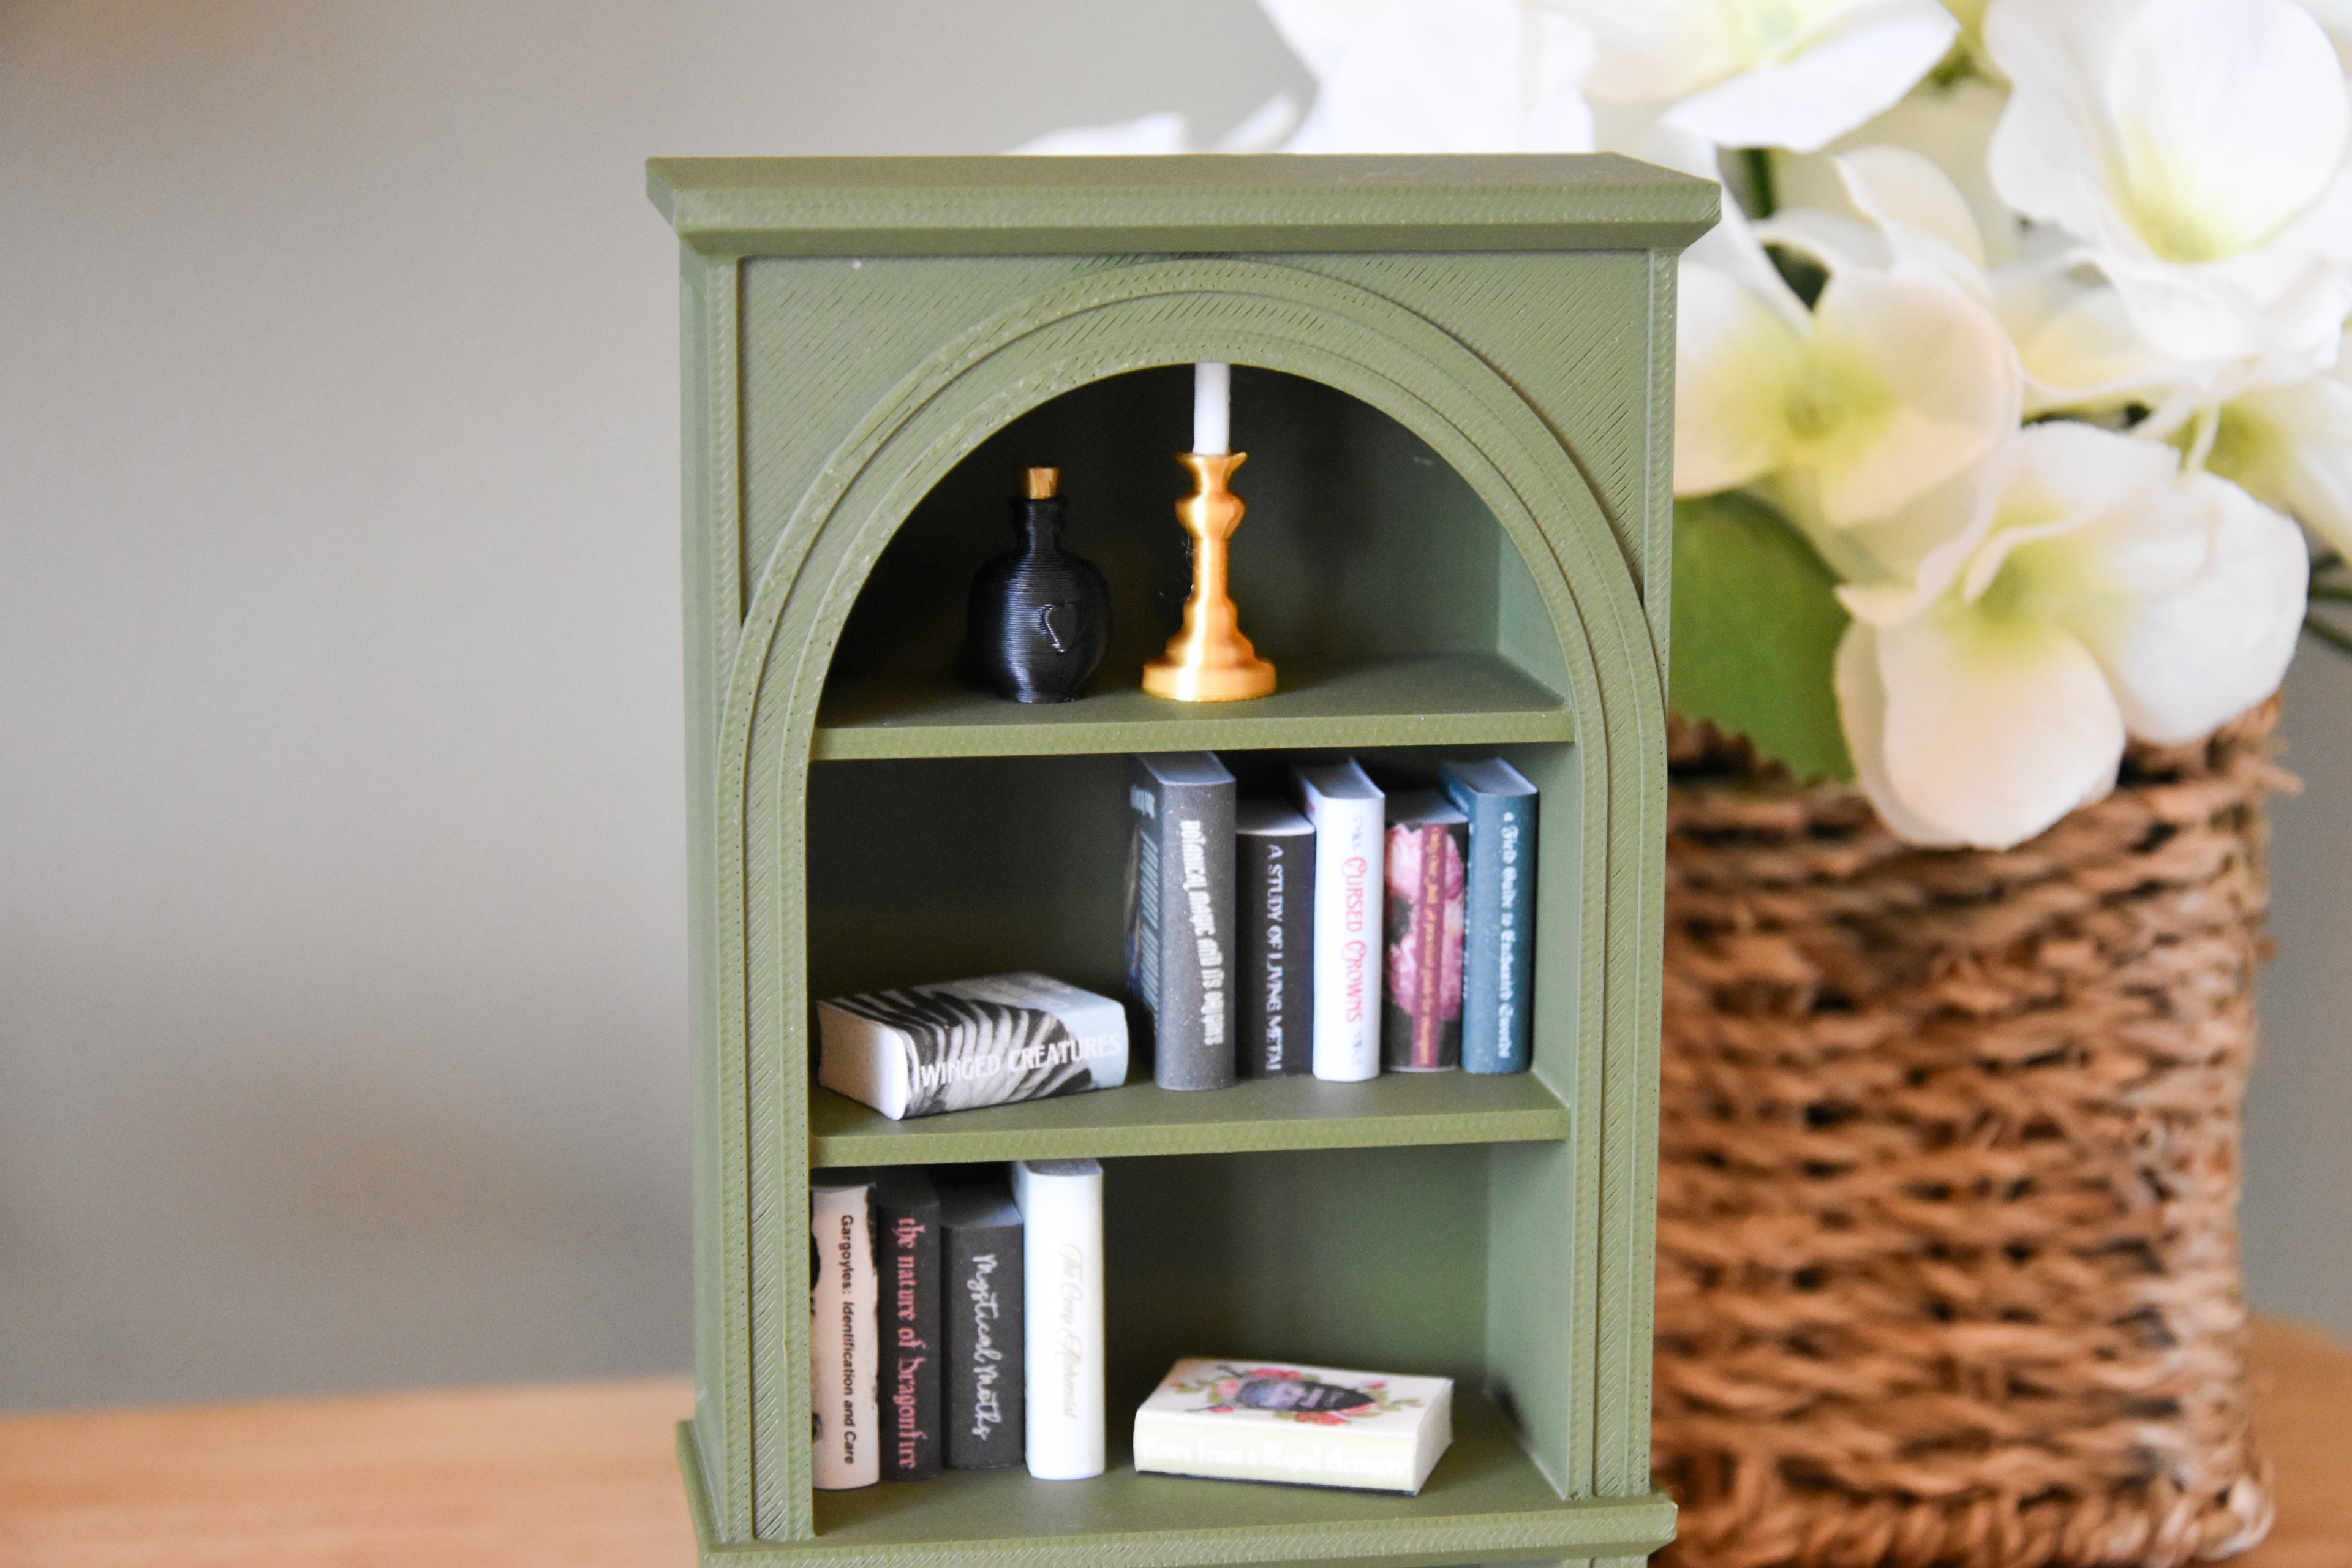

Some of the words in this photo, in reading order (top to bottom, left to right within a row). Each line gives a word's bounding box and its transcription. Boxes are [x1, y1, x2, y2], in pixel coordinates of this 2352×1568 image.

[1267, 844, 1284, 859] A
[1501, 825, 1518, 864] Field
[1267, 864, 1284, 922] STUDY
[1502, 866, 1516, 909] Guide
[1267, 925, 1283, 951] OF
[1501, 913, 1514, 927] to
[1265, 952, 1283, 1012] LIVING
[1499, 930, 1515, 1001] Enchanted
[921, 1055, 1000, 1087] WINGED
[1009, 1032, 1121, 1072] CREATURES
[839, 1215, 854, 1295] Gargoyles:
[892, 1217, 925, 1248] the
[897, 1255, 916, 1321] nature
[1058, 1243, 1085, 1284] The
[967, 1254, 1002, 1363] Mystical
[842, 1301, 855, 1395] Identification
[897, 1326, 927, 1350] of
[1055, 1327, 1084, 1420] Alchemist
[843, 1400, 856, 1427] and
[894, 1356, 927, 1469] Dragonfire
[972, 1364, 1001, 1441] Moths
[843, 1430, 856, 1466] Care
